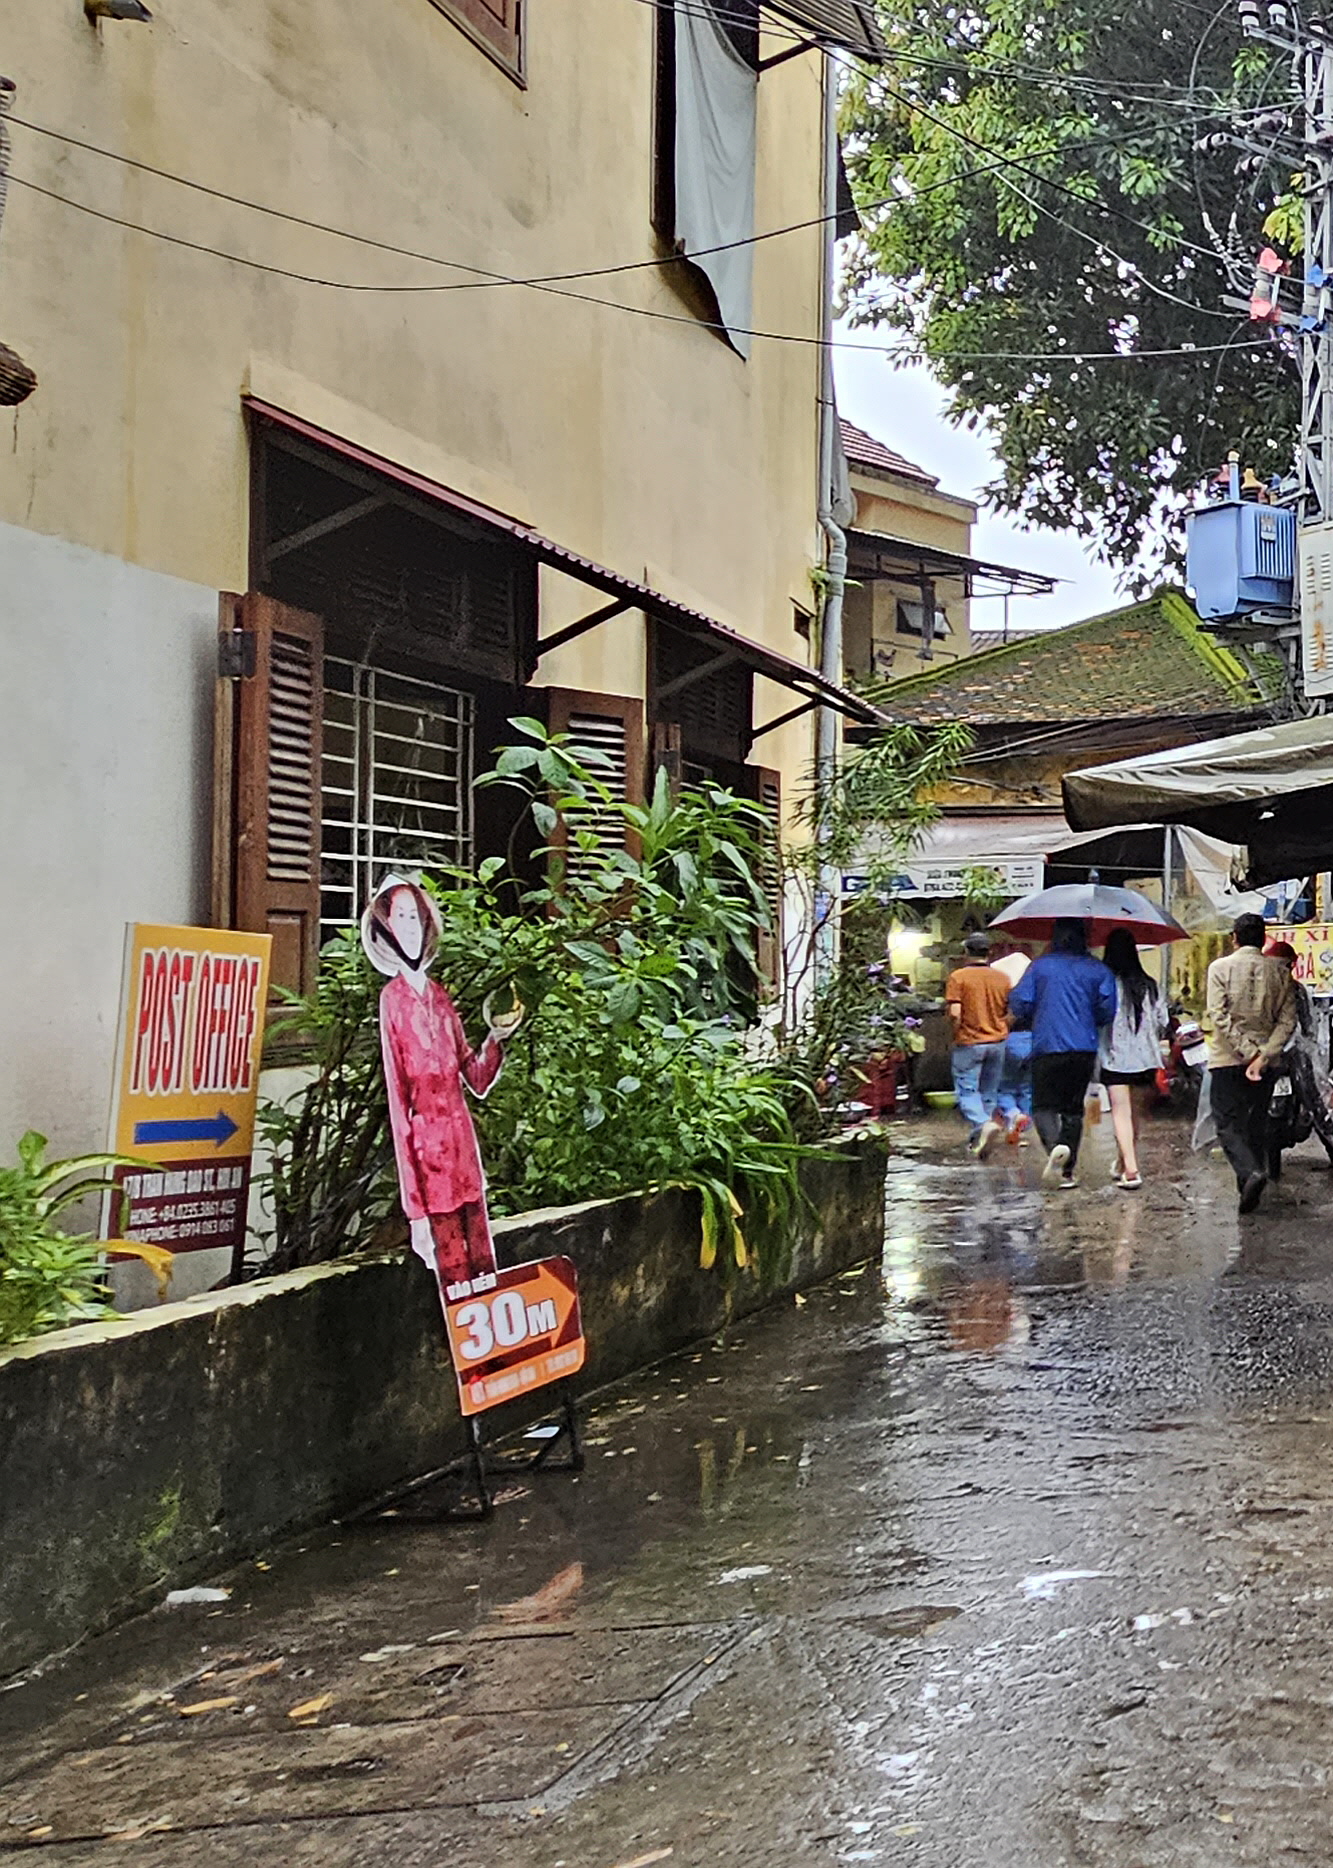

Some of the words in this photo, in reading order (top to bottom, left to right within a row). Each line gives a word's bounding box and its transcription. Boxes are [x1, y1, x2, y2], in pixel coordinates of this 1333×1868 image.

[130, 948, 196, 1096] POST
[190, 950, 262, 1096] OFFICE
[455, 1290, 559, 1361] 30M
